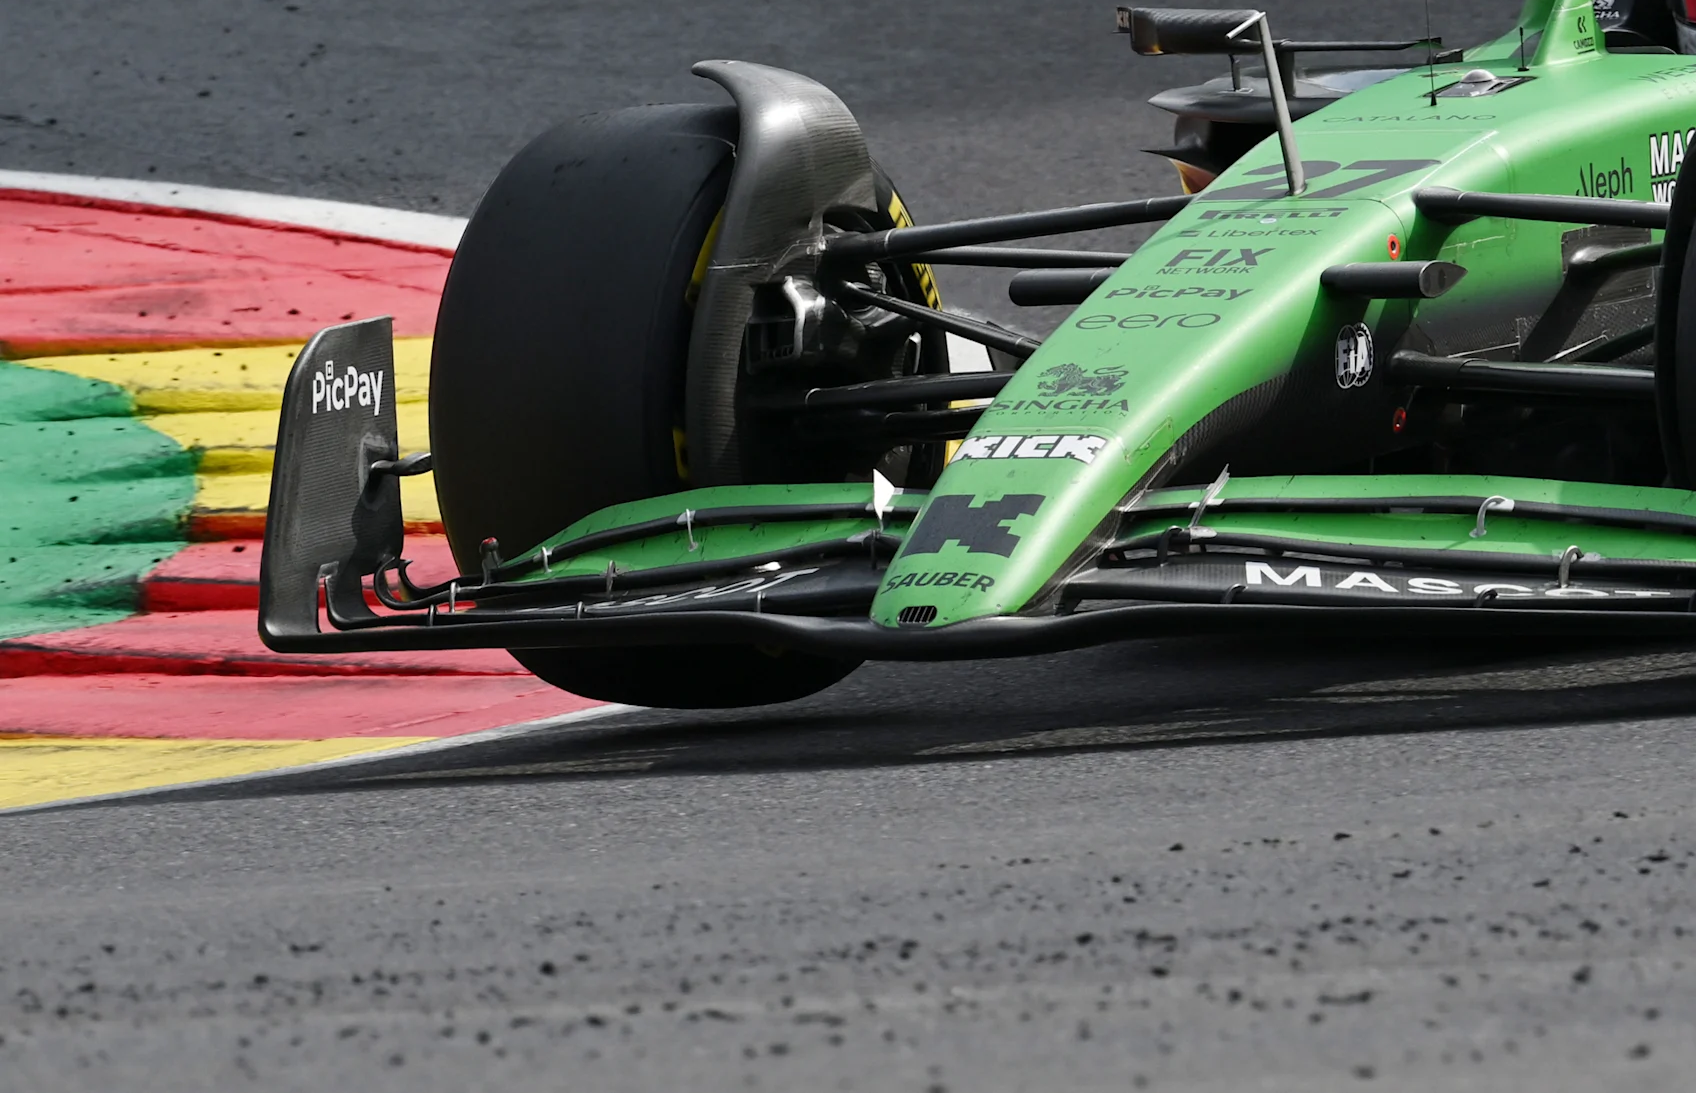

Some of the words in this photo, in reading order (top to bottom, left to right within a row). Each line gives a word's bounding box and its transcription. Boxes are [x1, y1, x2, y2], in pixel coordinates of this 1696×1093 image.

[1322, 114, 1497, 123] CATALANO
[1200, 159, 1443, 199] 27
[1197, 207, 1349, 220] PIRELLI
[1207, 226, 1322, 238] Libertex
[1165, 247, 1276, 267] FIX
[1156, 266, 1255, 275] NETWORK
[1104, 285, 1254, 300] PicPay
[1075, 313, 1221, 330] eero
[312, 360, 384, 416] PicPay
[989, 399, 1130, 412] SINGHA
[948, 435, 1108, 466] KICK
[880, 572, 995, 595] SAUBER
[1244, 560, 1671, 598] MASCOT
